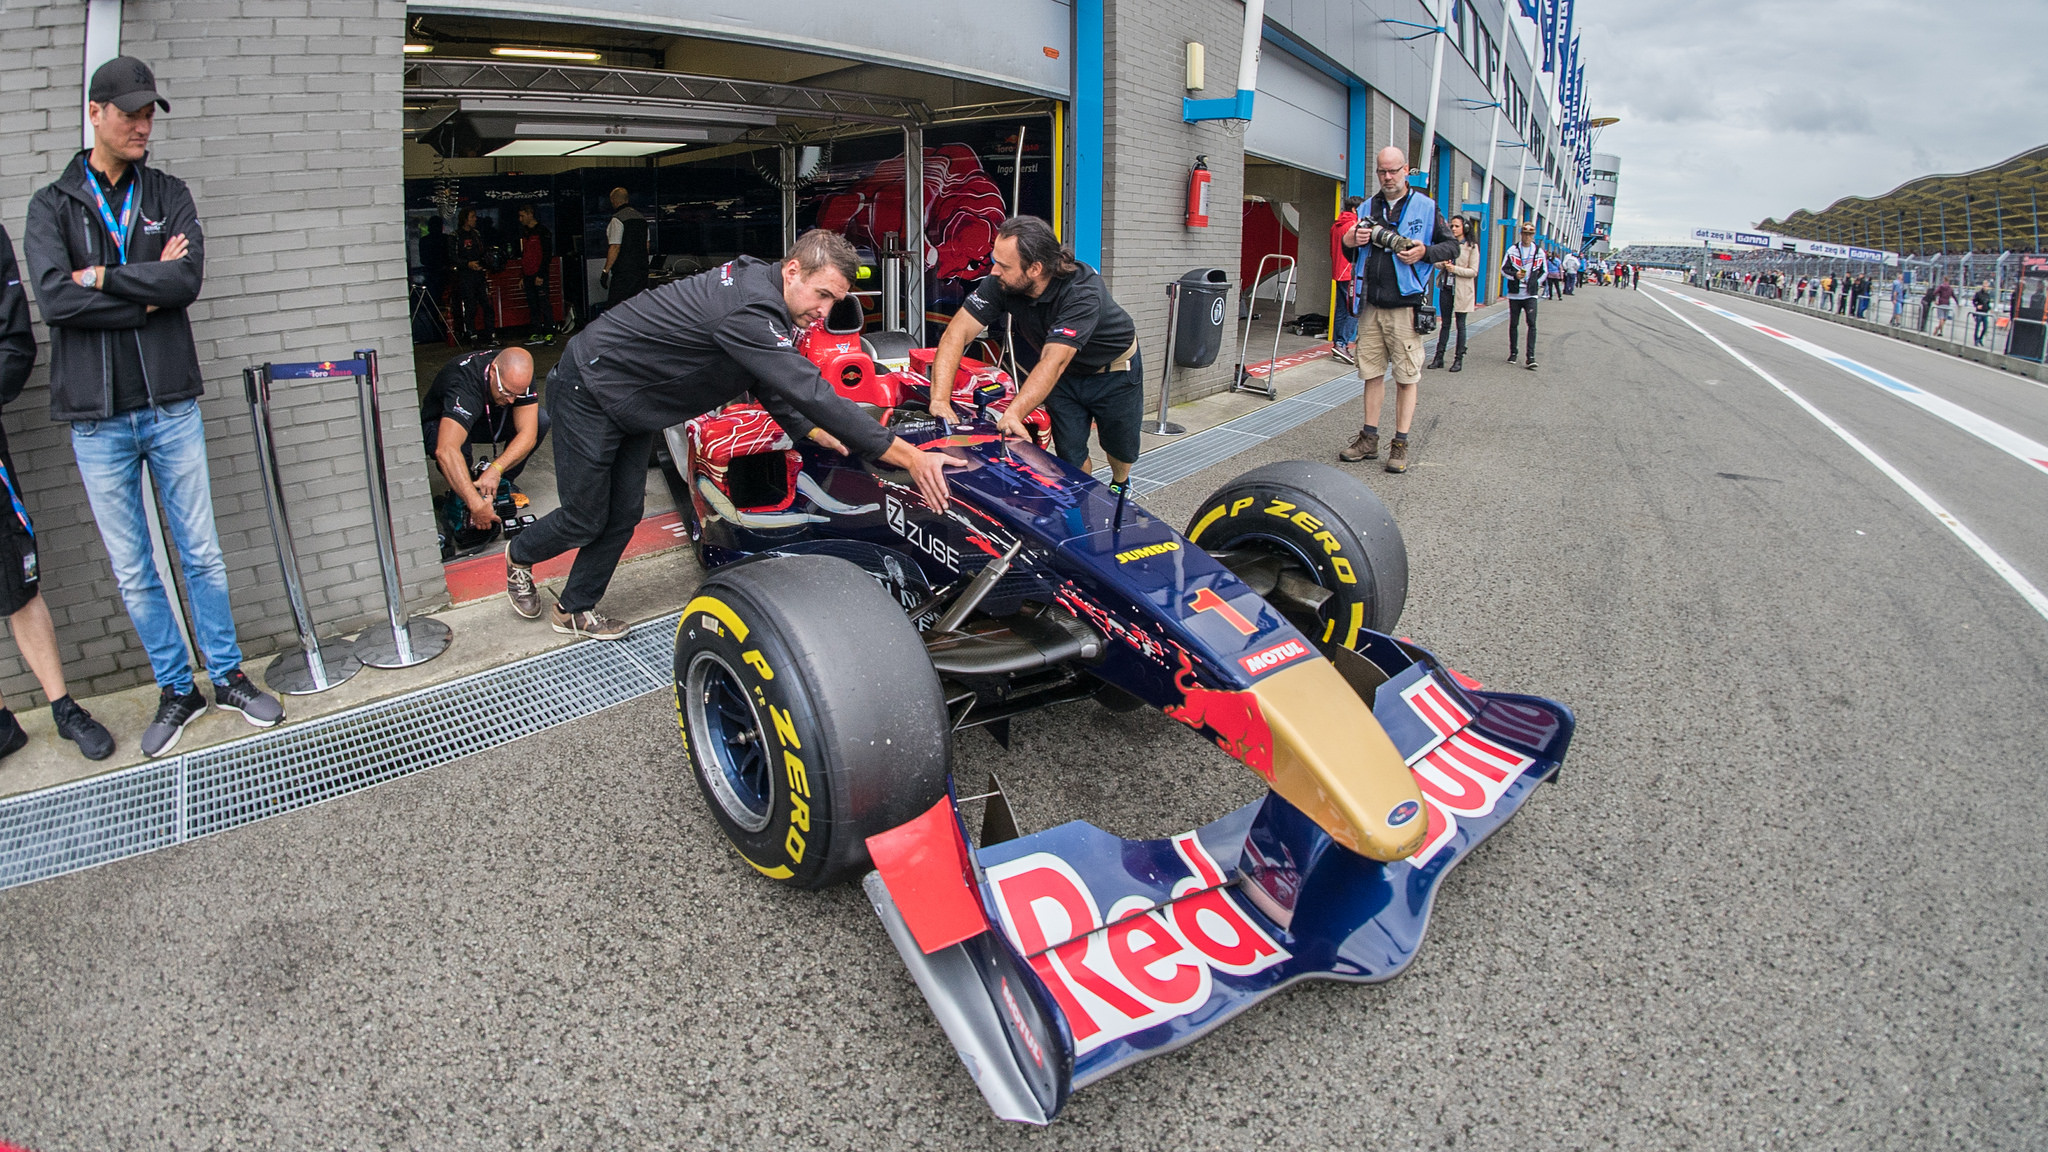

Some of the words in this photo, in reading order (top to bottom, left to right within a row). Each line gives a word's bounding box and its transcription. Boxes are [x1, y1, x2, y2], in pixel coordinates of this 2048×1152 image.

[997, 164, 1014, 176] Ingo
[1018, 163, 1039, 173] erstl
[1696, 229, 1709, 237] dat
[1726, 232, 1733, 240] ik
[1810, 243, 1823, 251] dat
[906, 519, 960, 574] ZUSE
[1115, 541, 1180, 564] JUMBO
[1230, 496, 1254, 517] P
[1264, 499, 1358, 584] ZERO
[1188, 587, 1259, 636] 1
[1245, 640, 1305, 673] MOTUL
[742, 649, 774, 681] P
[769, 704, 811, 865] ZERO
[992, 834, 1286, 1050] Red
[1003, 984, 1041, 1062] MOTUL
